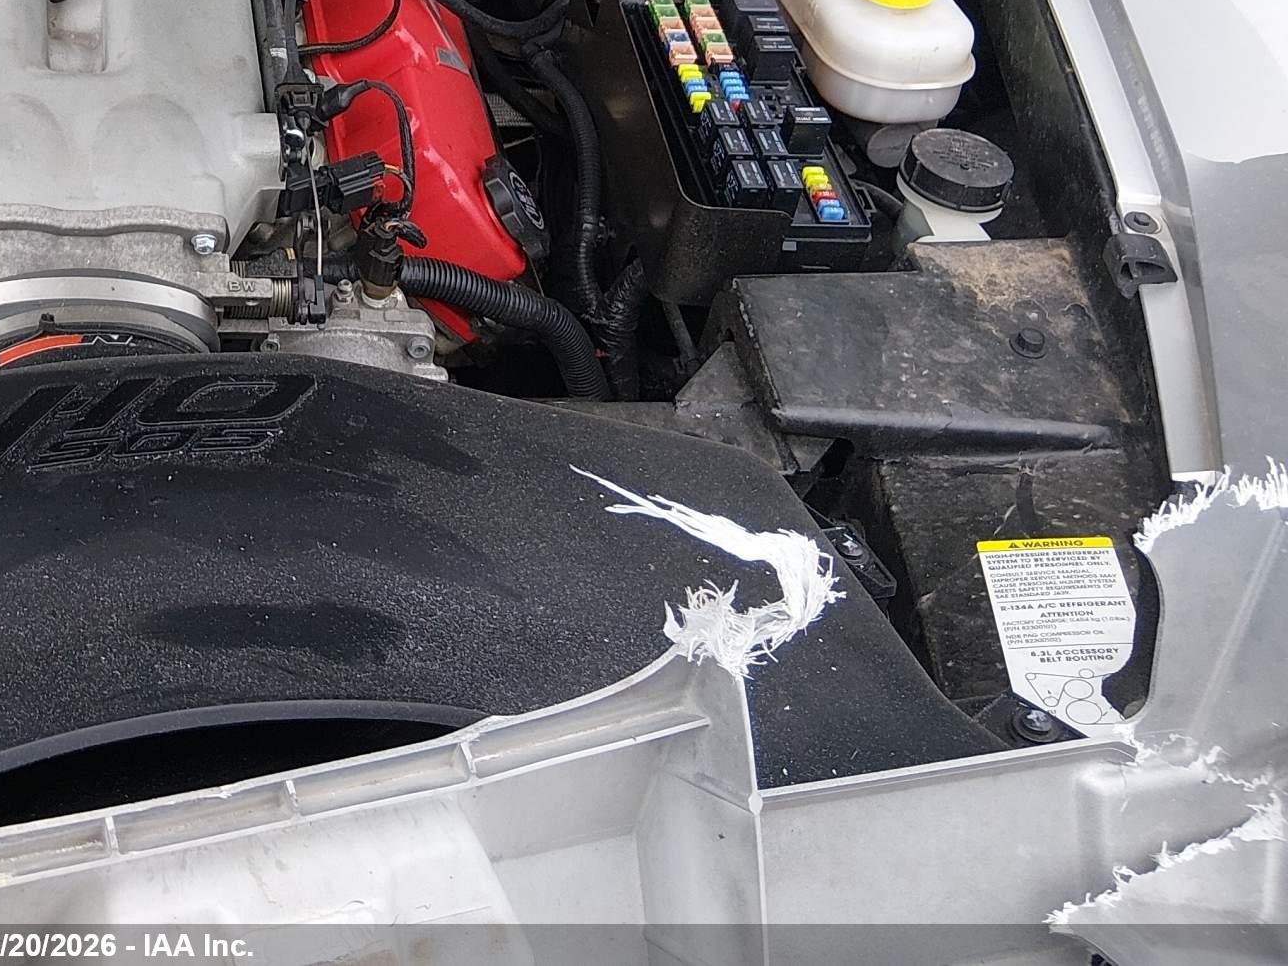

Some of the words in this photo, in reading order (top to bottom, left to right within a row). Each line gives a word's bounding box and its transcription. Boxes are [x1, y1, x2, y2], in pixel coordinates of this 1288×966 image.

[228, 280, 256, 293] BW
[26, 427, 284, 472] 505
[1022, 539, 1084, 548] WARNING
[988, 563, 1032, 571] QUALIFIED
[1059, 600, 1128, 608] REFRIGERANT
[1040, 610, 1094, 618] ATTENTION
[1055, 648, 1119, 656] ACCESSORY
[1065, 654, 1114, 662] ROUTING
